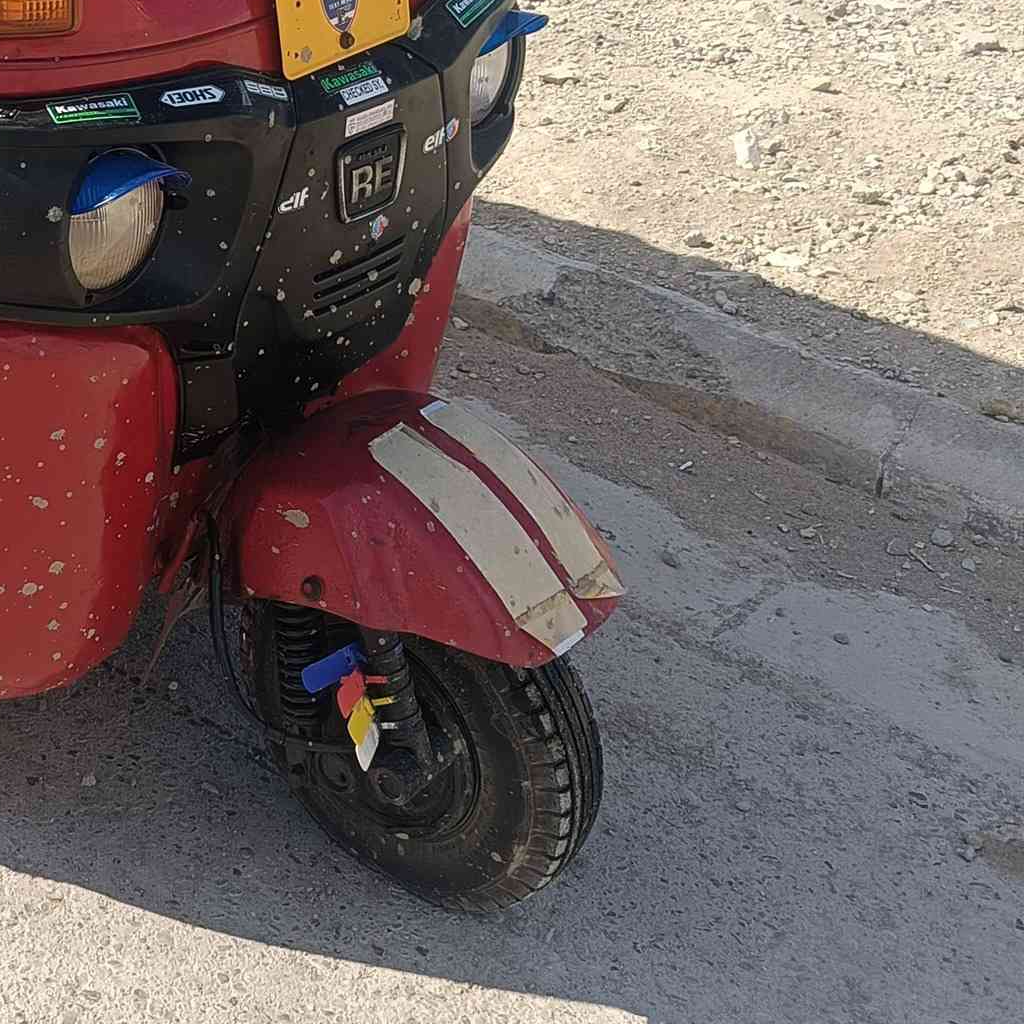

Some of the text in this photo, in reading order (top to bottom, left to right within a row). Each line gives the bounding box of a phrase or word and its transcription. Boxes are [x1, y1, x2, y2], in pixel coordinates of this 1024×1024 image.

[322, 63, 377, 90] Kawasaki
[54, 97, 129, 114] Kawasaki
[423, 127, 448, 154] elf
[351, 154, 394, 204] RE
